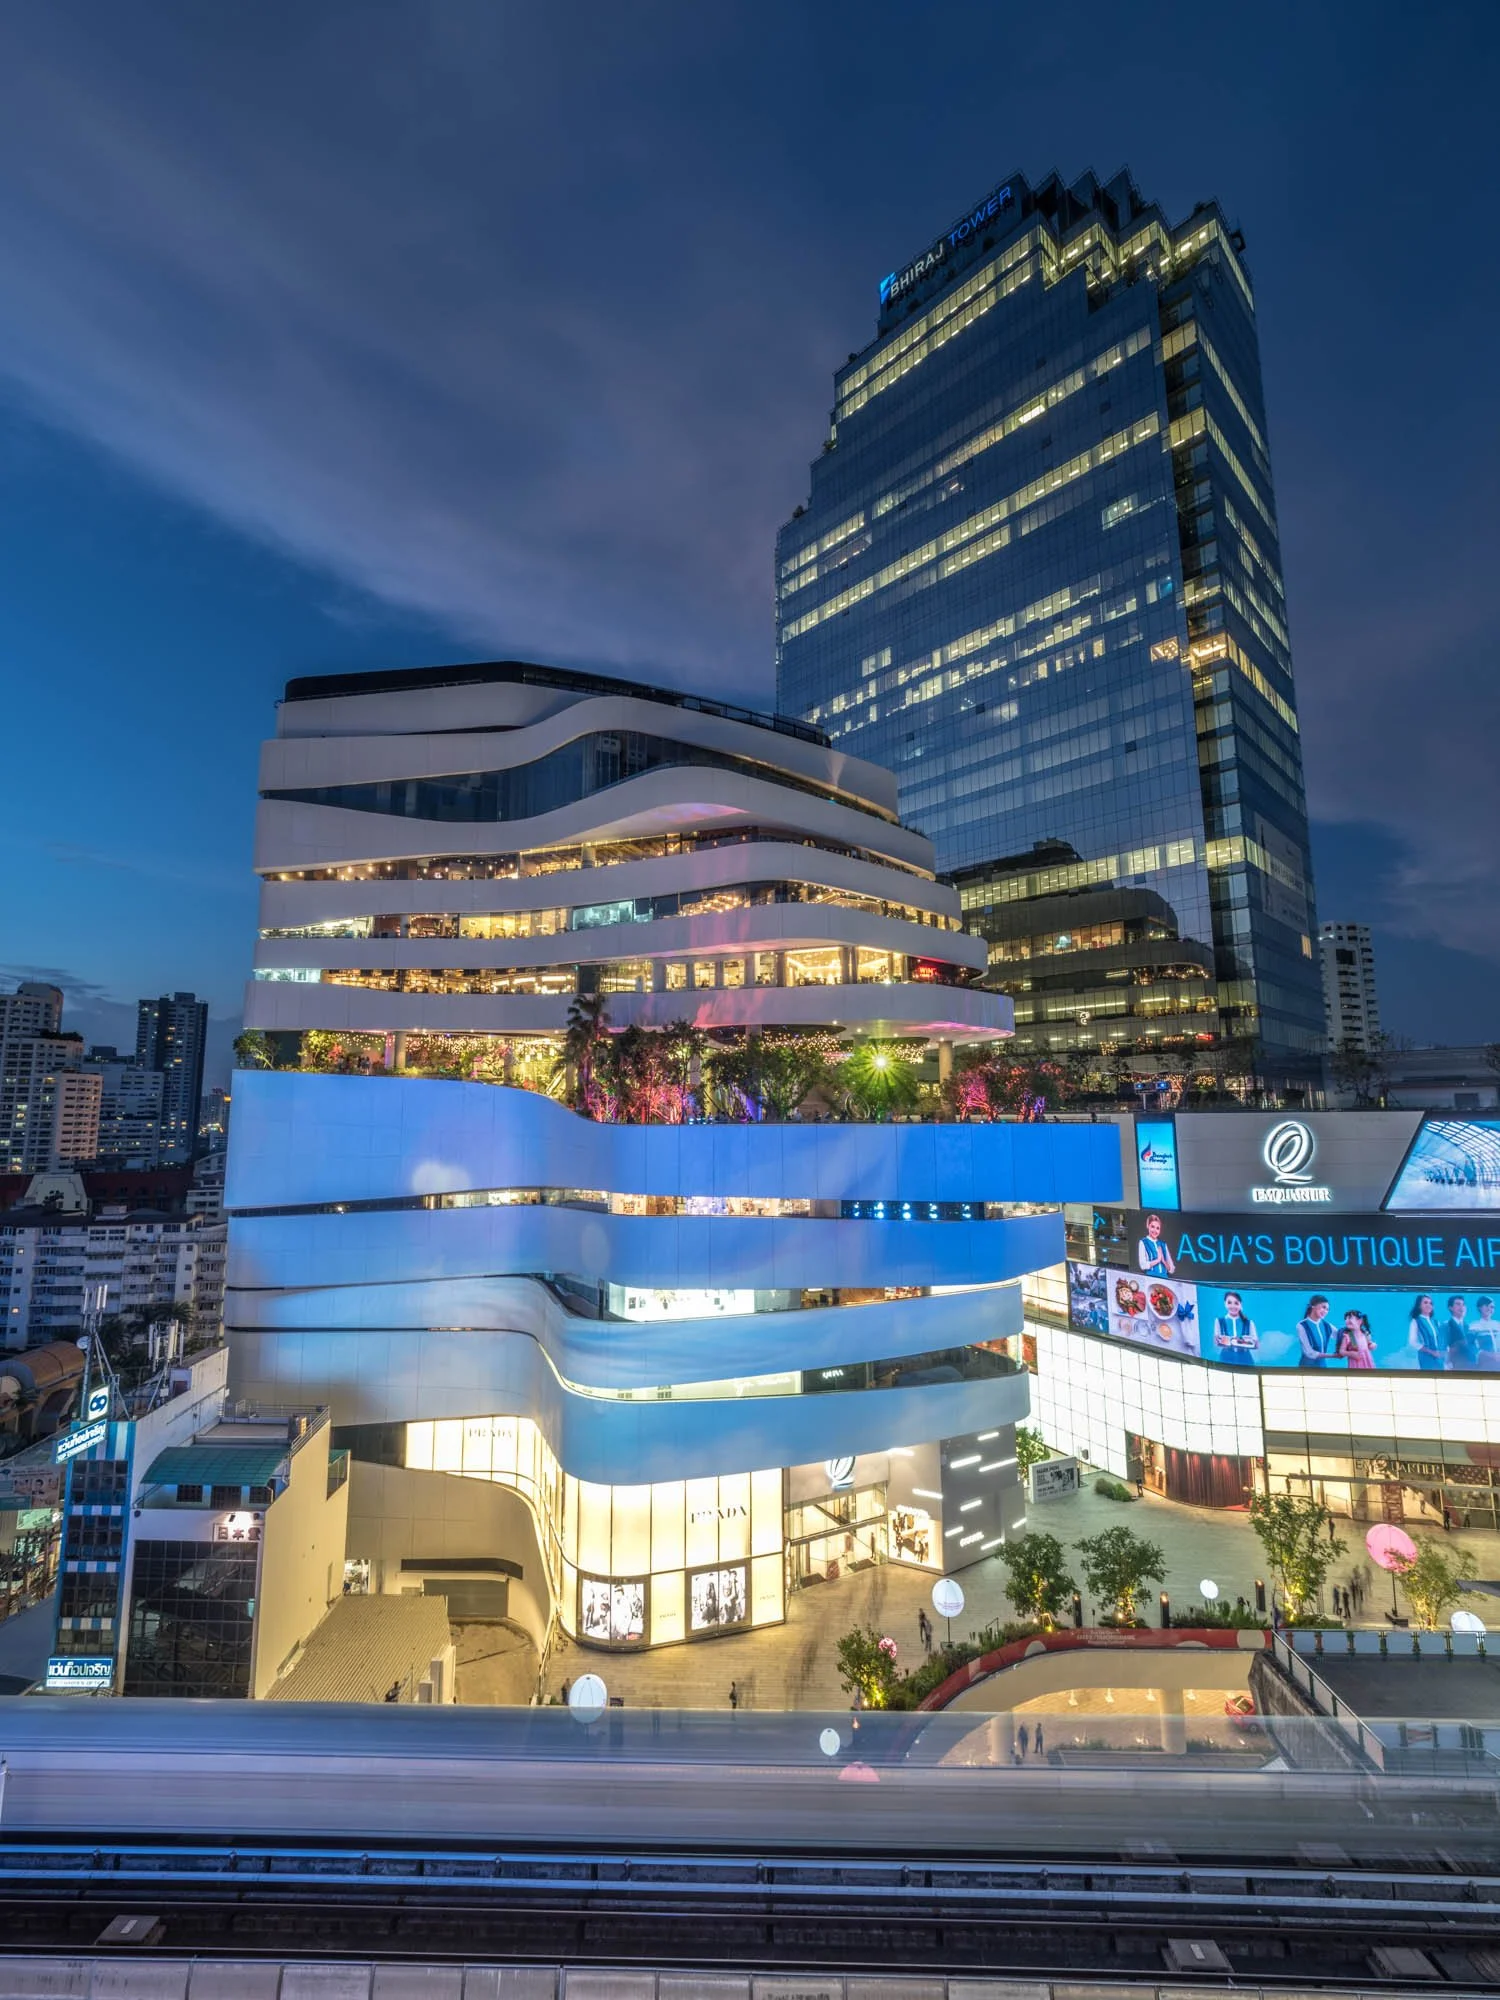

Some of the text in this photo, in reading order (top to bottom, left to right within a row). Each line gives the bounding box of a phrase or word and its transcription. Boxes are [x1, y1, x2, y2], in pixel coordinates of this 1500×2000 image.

[890, 186, 1011, 298] BHIRAJ TOWER
[1252, 1187, 1331, 1204] EMQUARTIER
[1176, 1233, 1275, 1265] ASIA'S
[1284, 1235, 1445, 1267] BOUTIQUE
